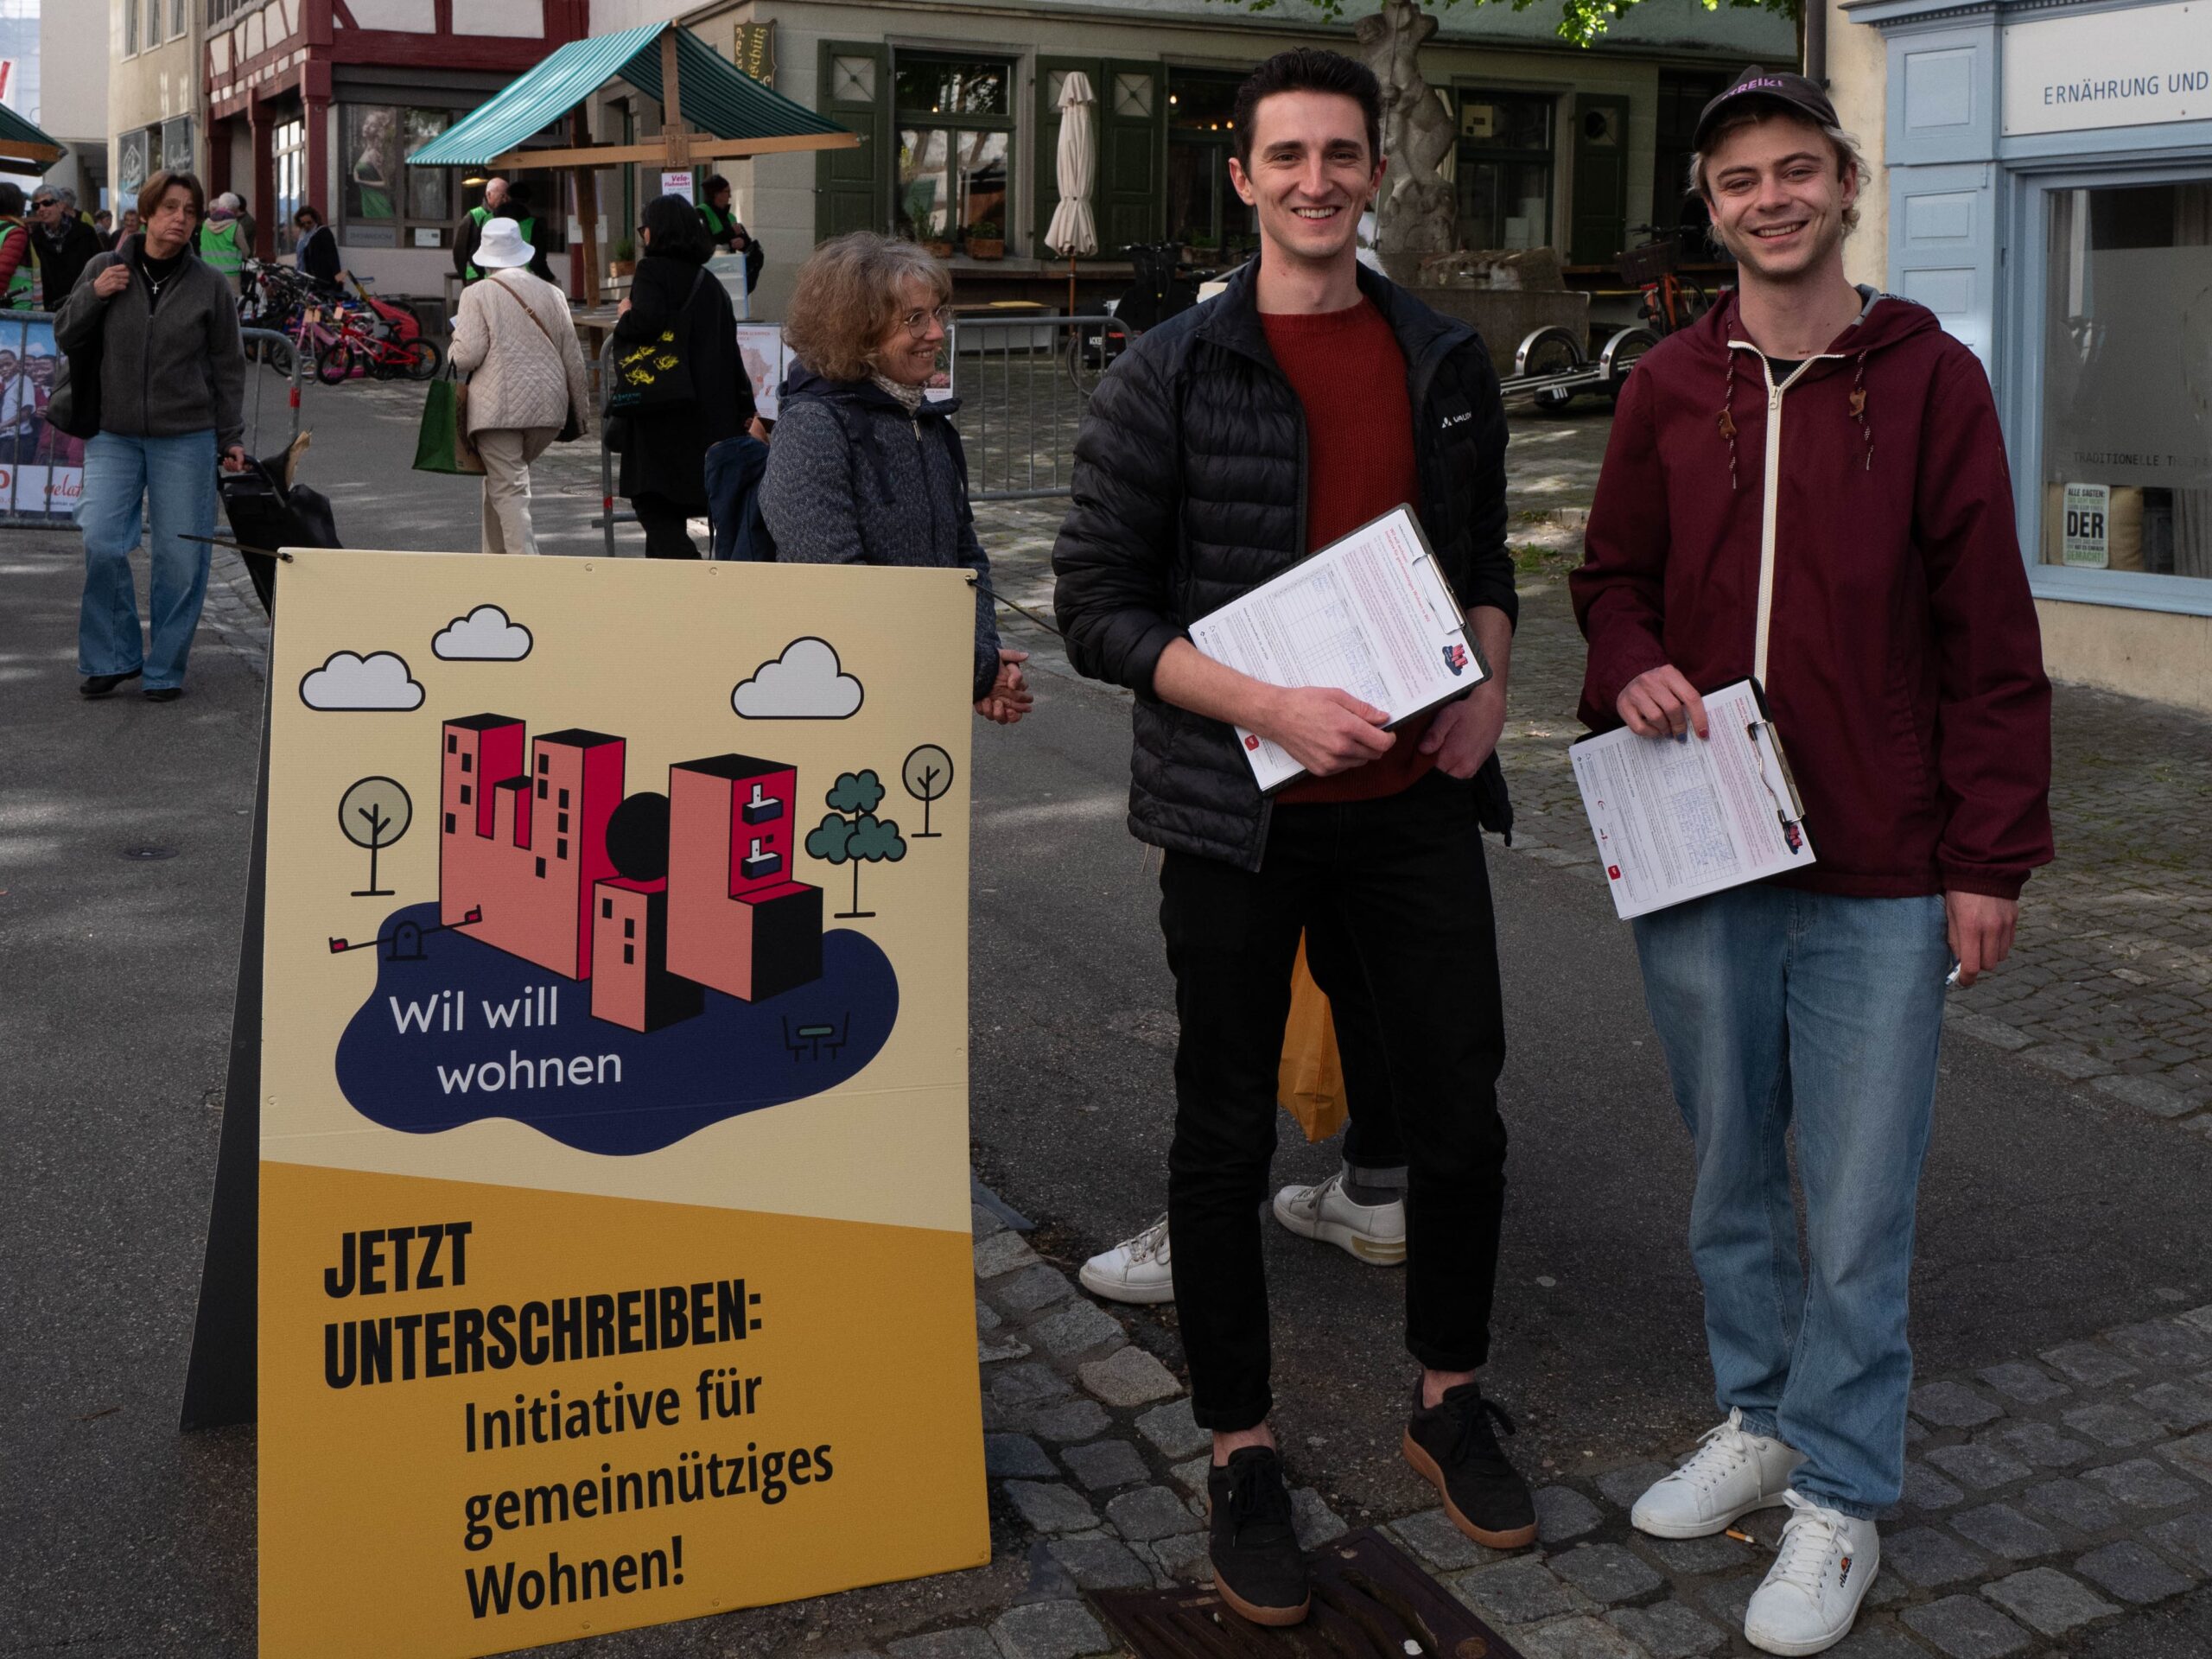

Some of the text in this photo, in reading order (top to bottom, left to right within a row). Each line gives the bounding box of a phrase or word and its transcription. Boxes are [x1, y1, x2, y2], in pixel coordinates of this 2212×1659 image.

[2044, 71, 2209, 105] ERNÄHRUNG UND
[2074, 451, 2159, 467] TRADITIONELLE
[2068, 488, 2105, 498] ALLE SAGTEN:
[2067, 511, 2104, 538] DER
[389, 986, 558, 1033] Wil will
[437, 1050, 623, 1094] wohnen
[324, 1221, 472, 1299] JETZT
[324, 1278, 762, 1389] UNTERSCHREIBEN:
[465, 1367, 762, 1452] Initiative für
[464, 1442, 834, 1551] gemeinnütziges
[465, 1535, 684, 1619] Wohnen!
